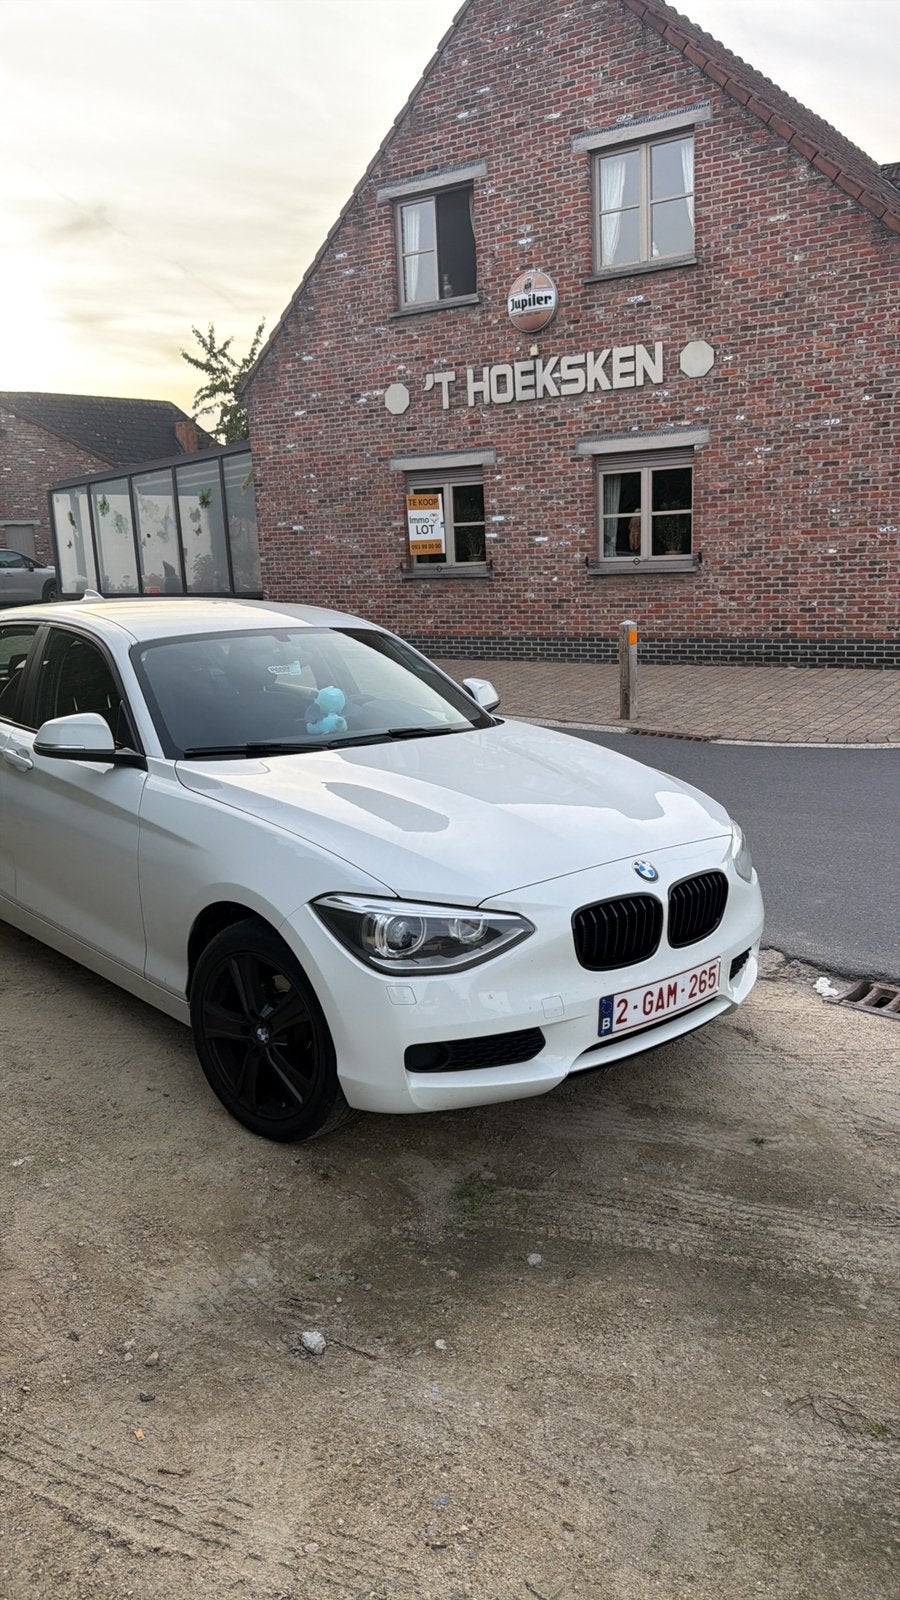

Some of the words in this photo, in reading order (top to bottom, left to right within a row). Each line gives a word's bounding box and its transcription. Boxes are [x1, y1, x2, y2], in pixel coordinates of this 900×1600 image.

[510, 293, 552, 311] Jupiler
[466, 341, 664, 407] HOEKSKEN
[418, 498, 438, 506] KOOP
[410, 516, 429, 524] Immo
[416, 525, 435, 534] LOT
[615, 965, 717, 1025] 2-GAM-265
[602, 1018, 611, 1029] B
